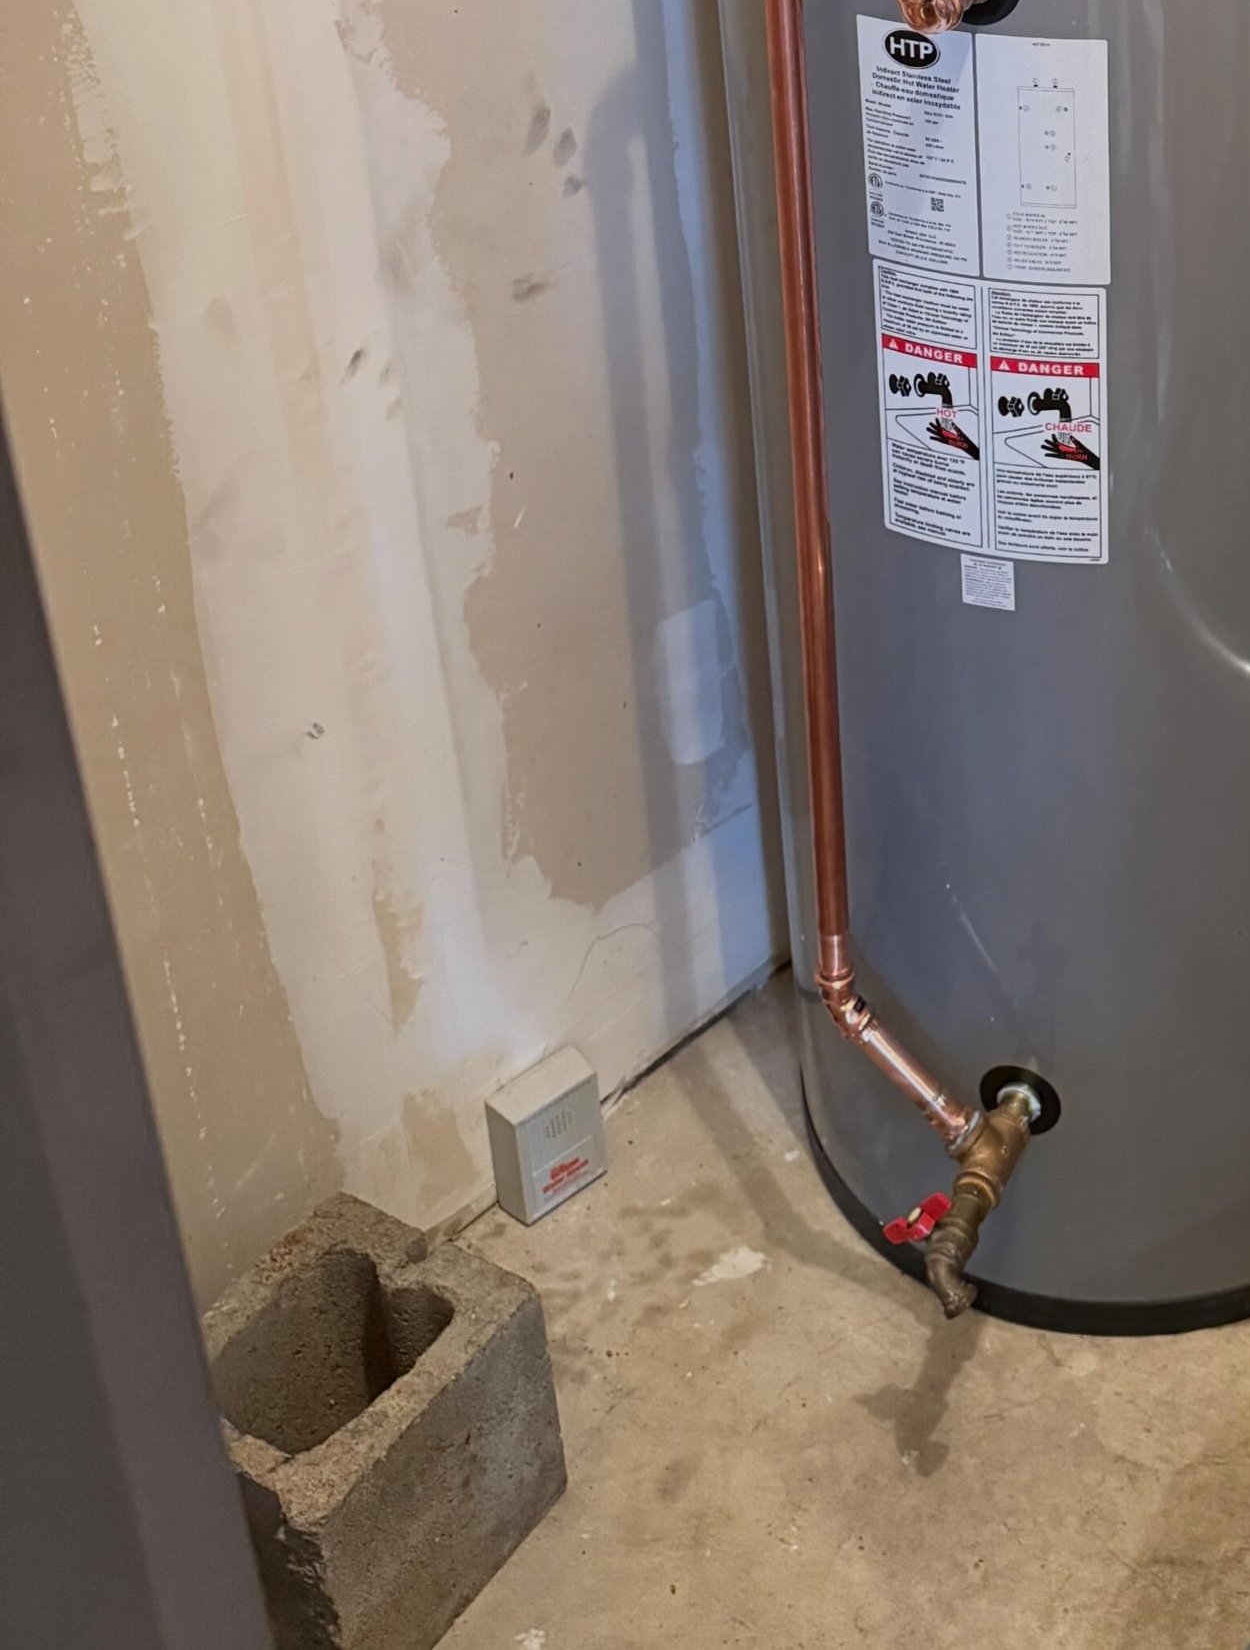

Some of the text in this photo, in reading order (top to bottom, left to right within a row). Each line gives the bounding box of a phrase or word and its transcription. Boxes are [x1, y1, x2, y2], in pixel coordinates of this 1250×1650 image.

[890, 37, 933, 59] HTP
[916, 81, 935, 89] Water
[906, 344, 963, 364] DANGER
[1019, 362, 1084, 375] DANGER
[937, 409, 956, 419] HOT
[1045, 423, 1092, 432] CHAUDE
